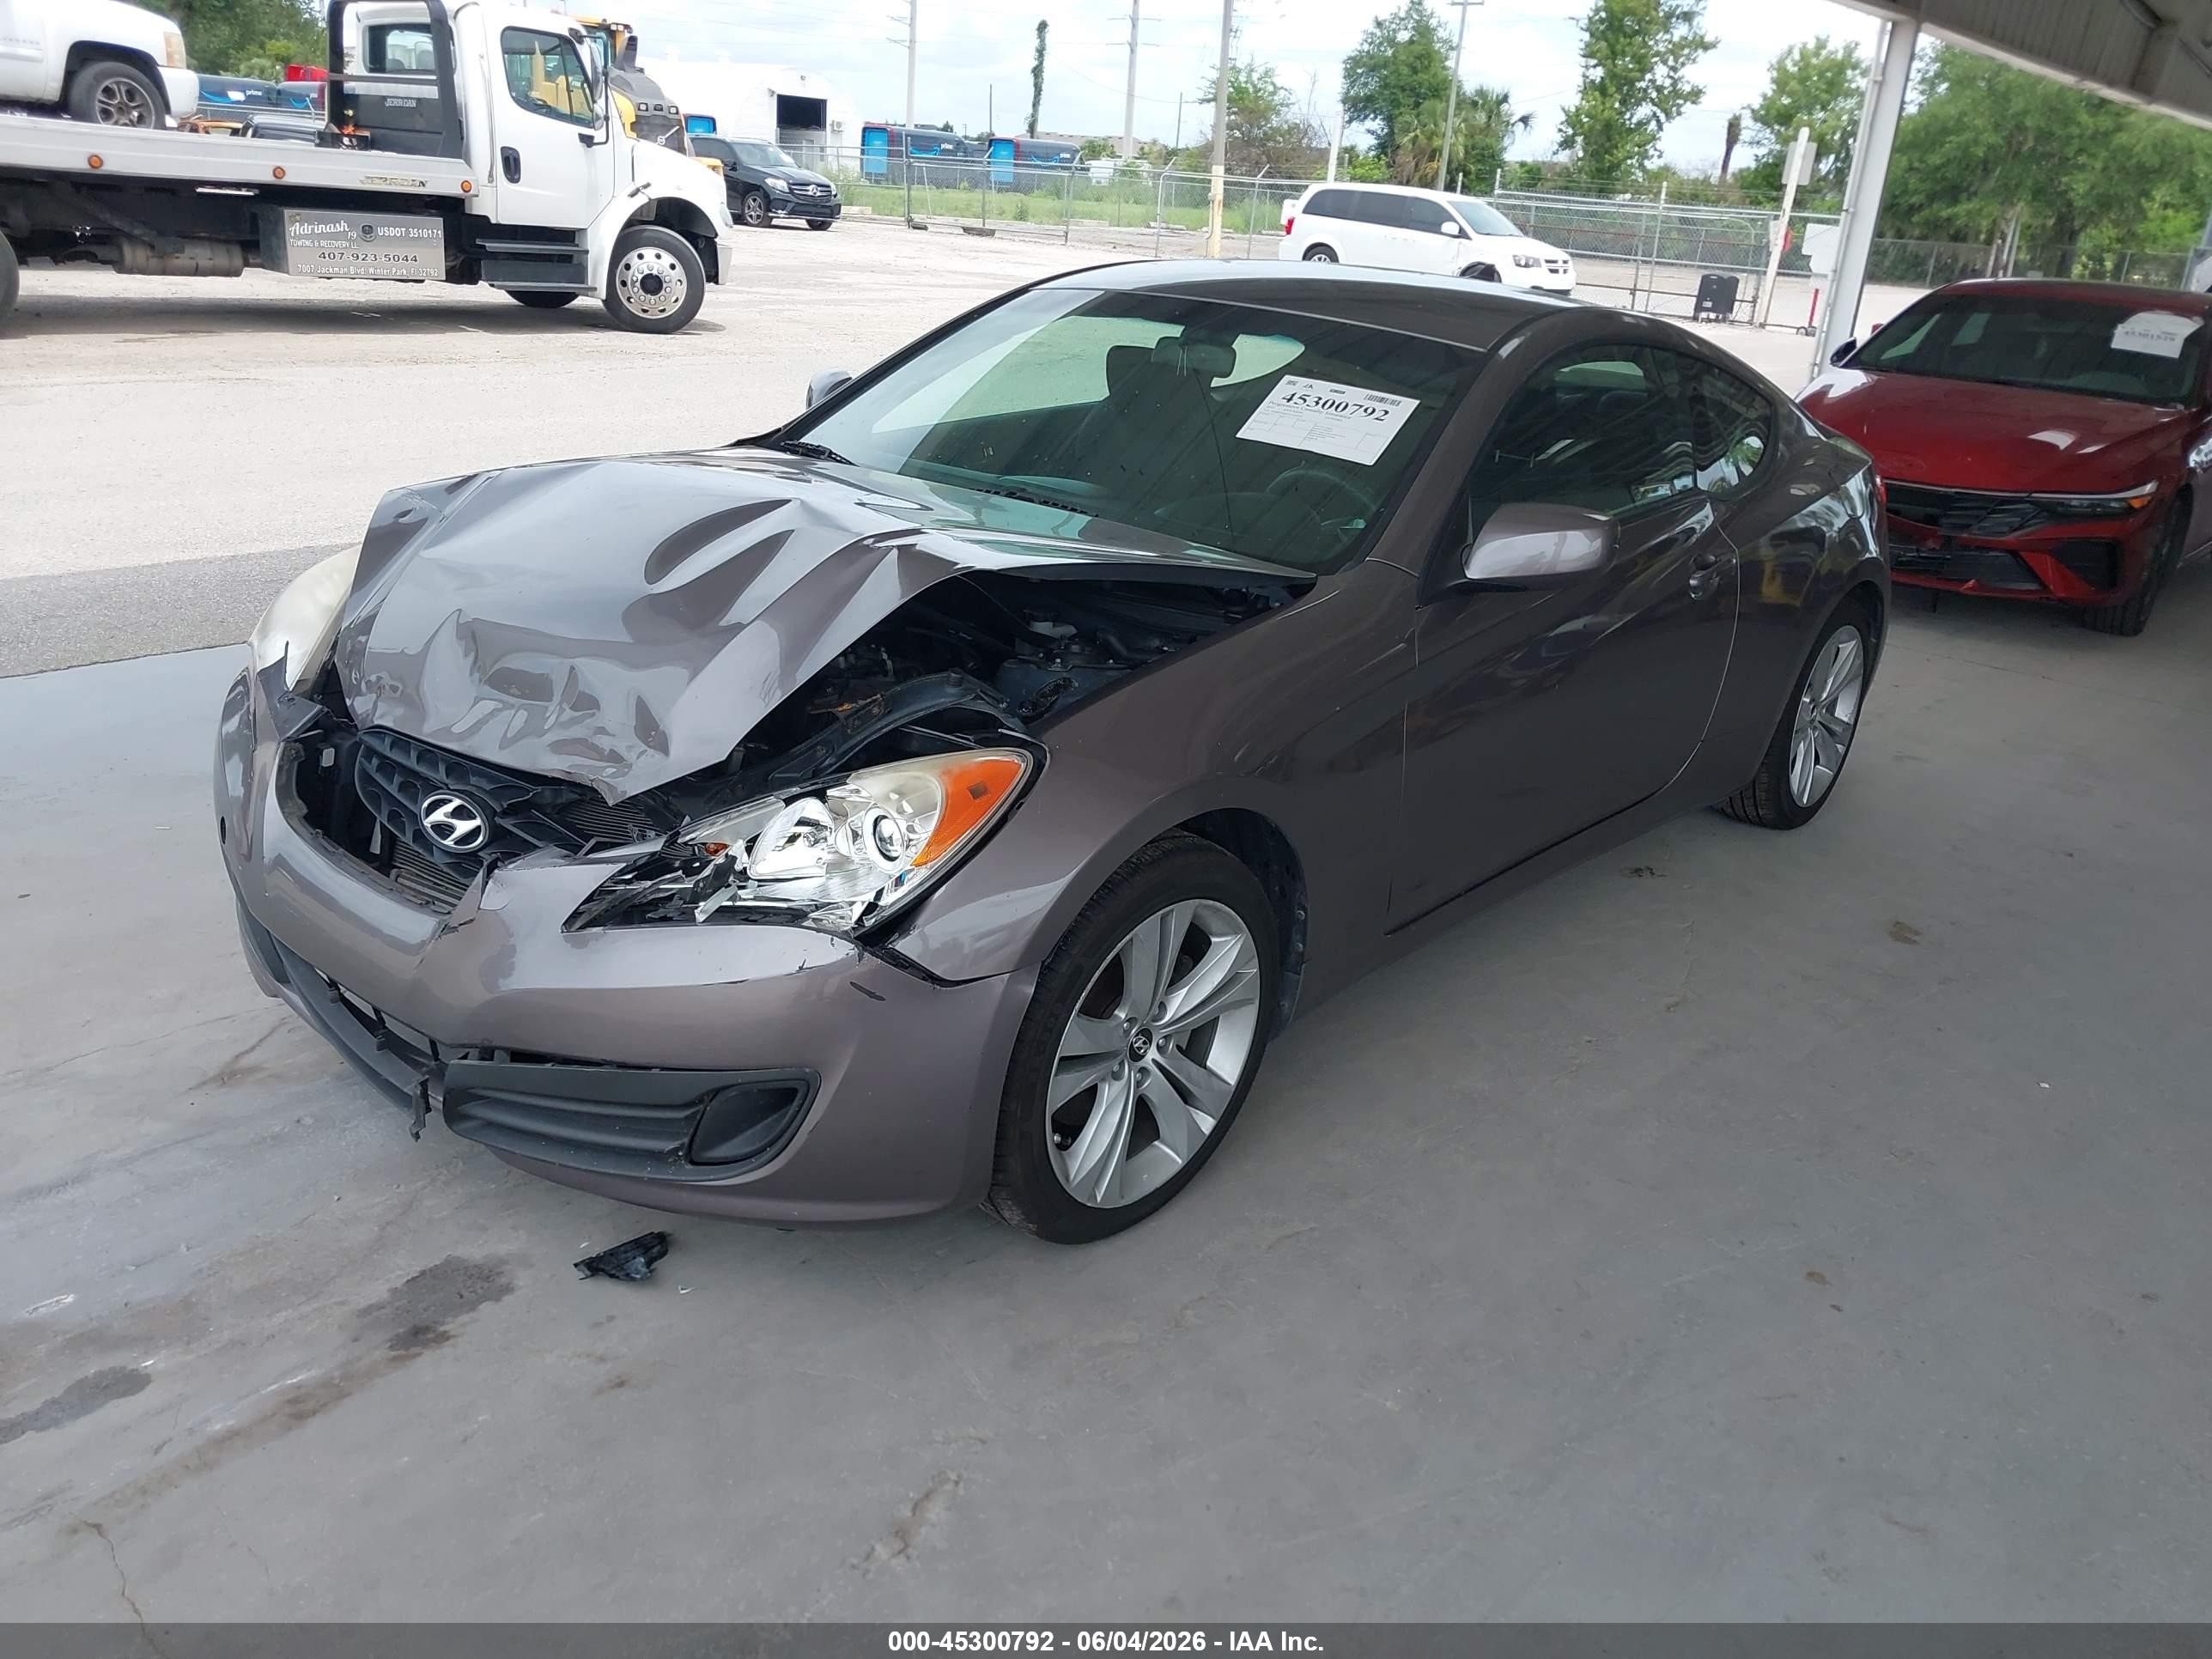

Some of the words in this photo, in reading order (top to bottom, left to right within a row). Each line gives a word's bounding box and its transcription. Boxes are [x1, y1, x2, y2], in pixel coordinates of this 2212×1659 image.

[289, 220, 349, 237] Adrinash
[348, 231, 357, 240] 19
[378, 227, 406, 237] USDOT
[408, 228, 442, 239] 3510171
[289, 239, 313, 247] TOWING
[318, 251, 419, 264] 407-923-5044
[297, 264, 315, 274] 7007
[317, 265, 348, 275] Jackman
[368, 267, 391, 276] Winter
[418, 268, 439, 276] 32792
[1281, 392, 1391, 422] 45300792
